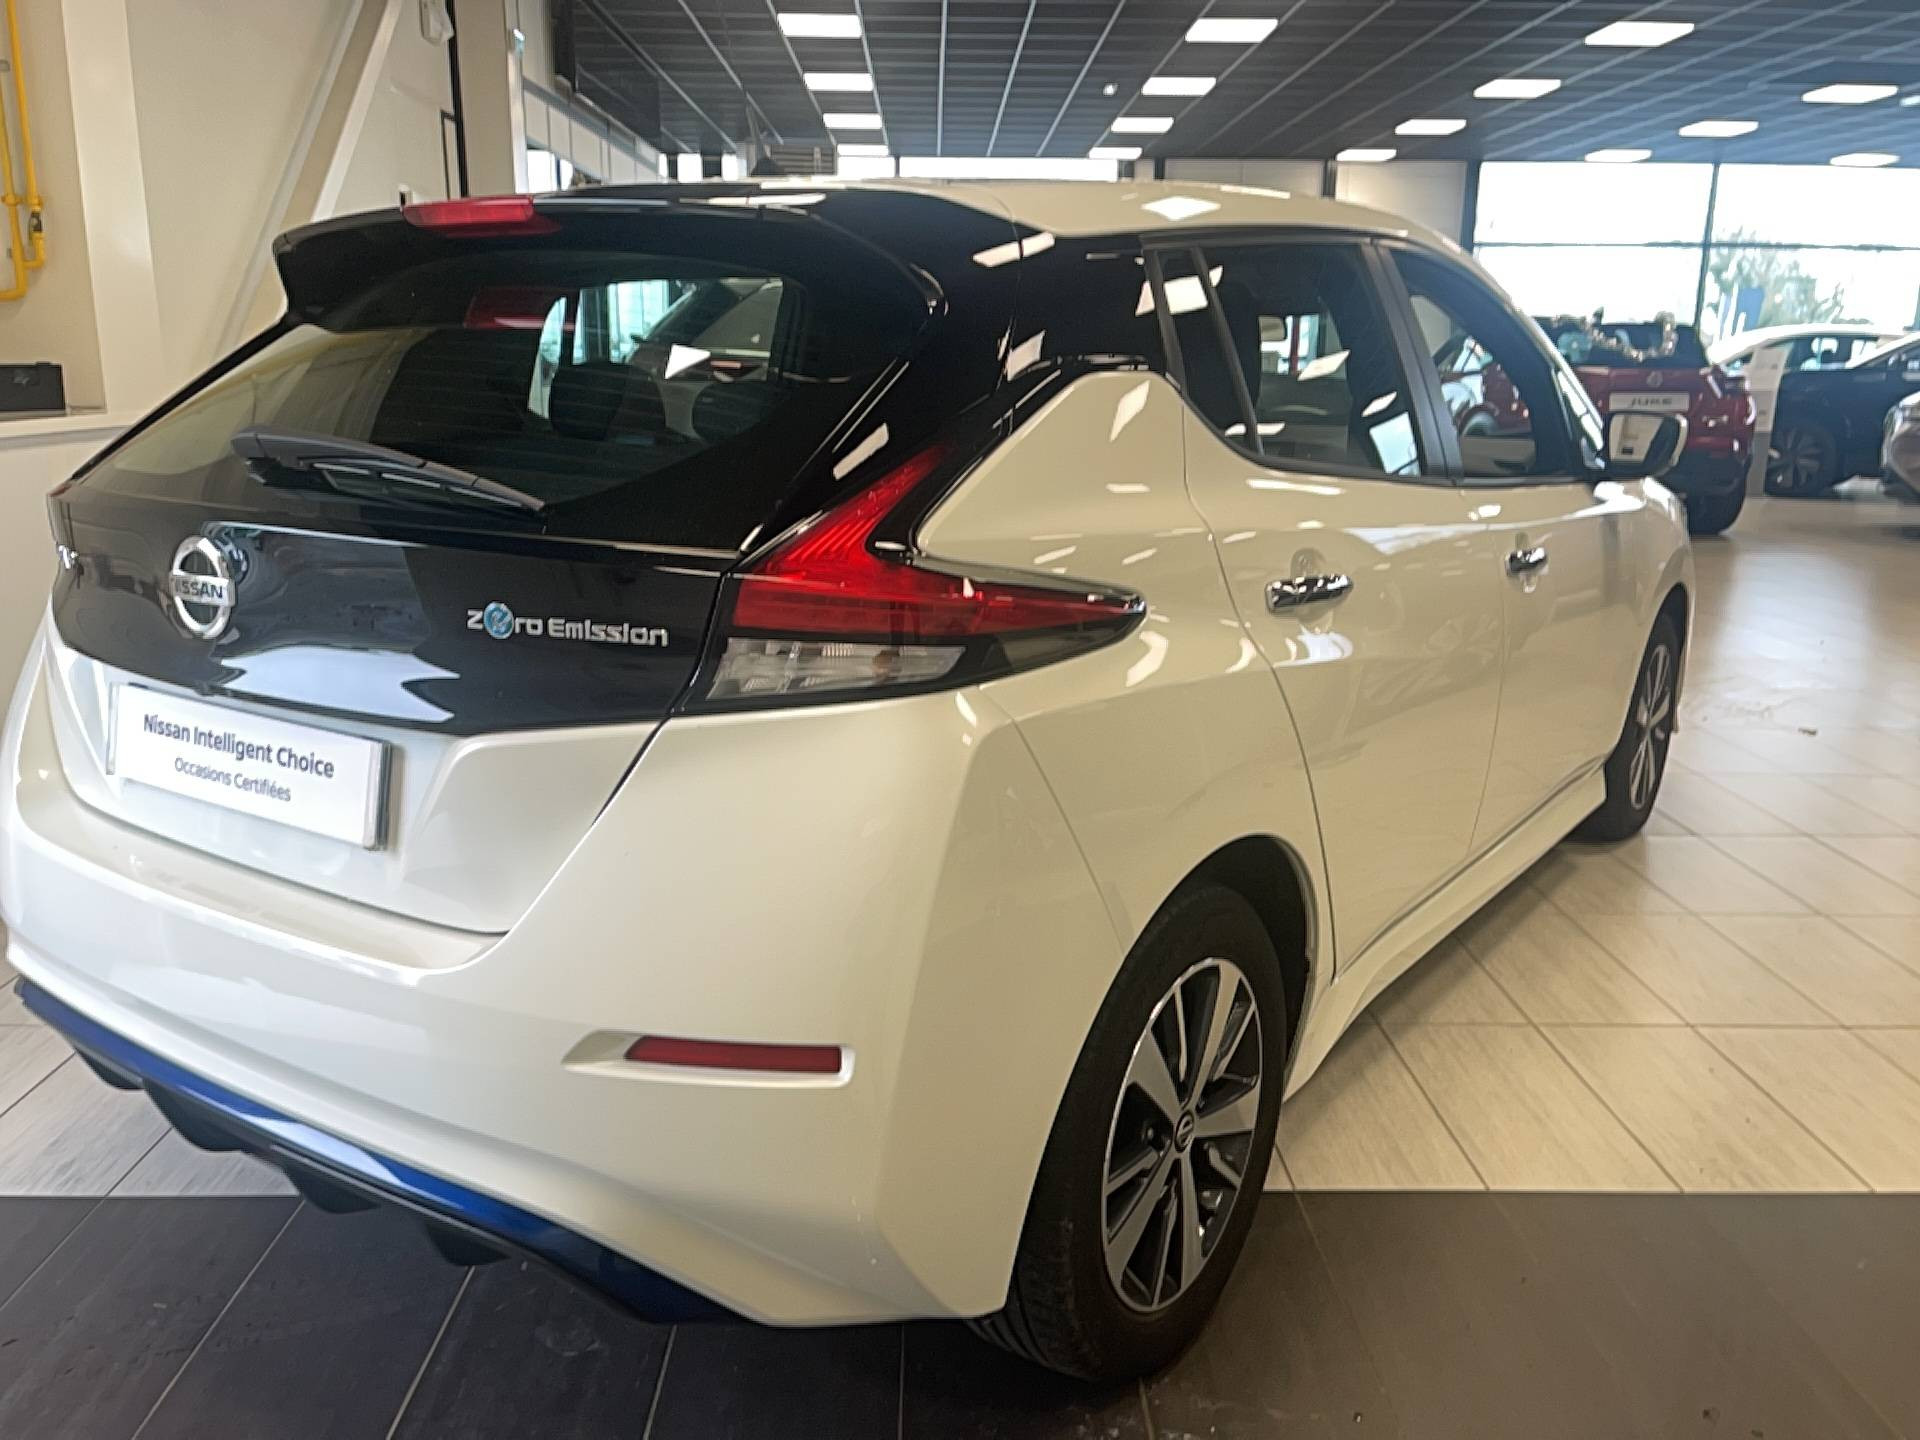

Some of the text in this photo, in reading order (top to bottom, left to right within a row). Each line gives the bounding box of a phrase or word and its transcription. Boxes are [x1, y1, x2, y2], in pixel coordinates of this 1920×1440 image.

[173, 578, 223, 599] ISSAN
[548, 617, 669, 647] Emission
[143, 714, 335, 778] Nissan Intelligent Choice
[174, 757, 292, 802] Occasions Certifiées
